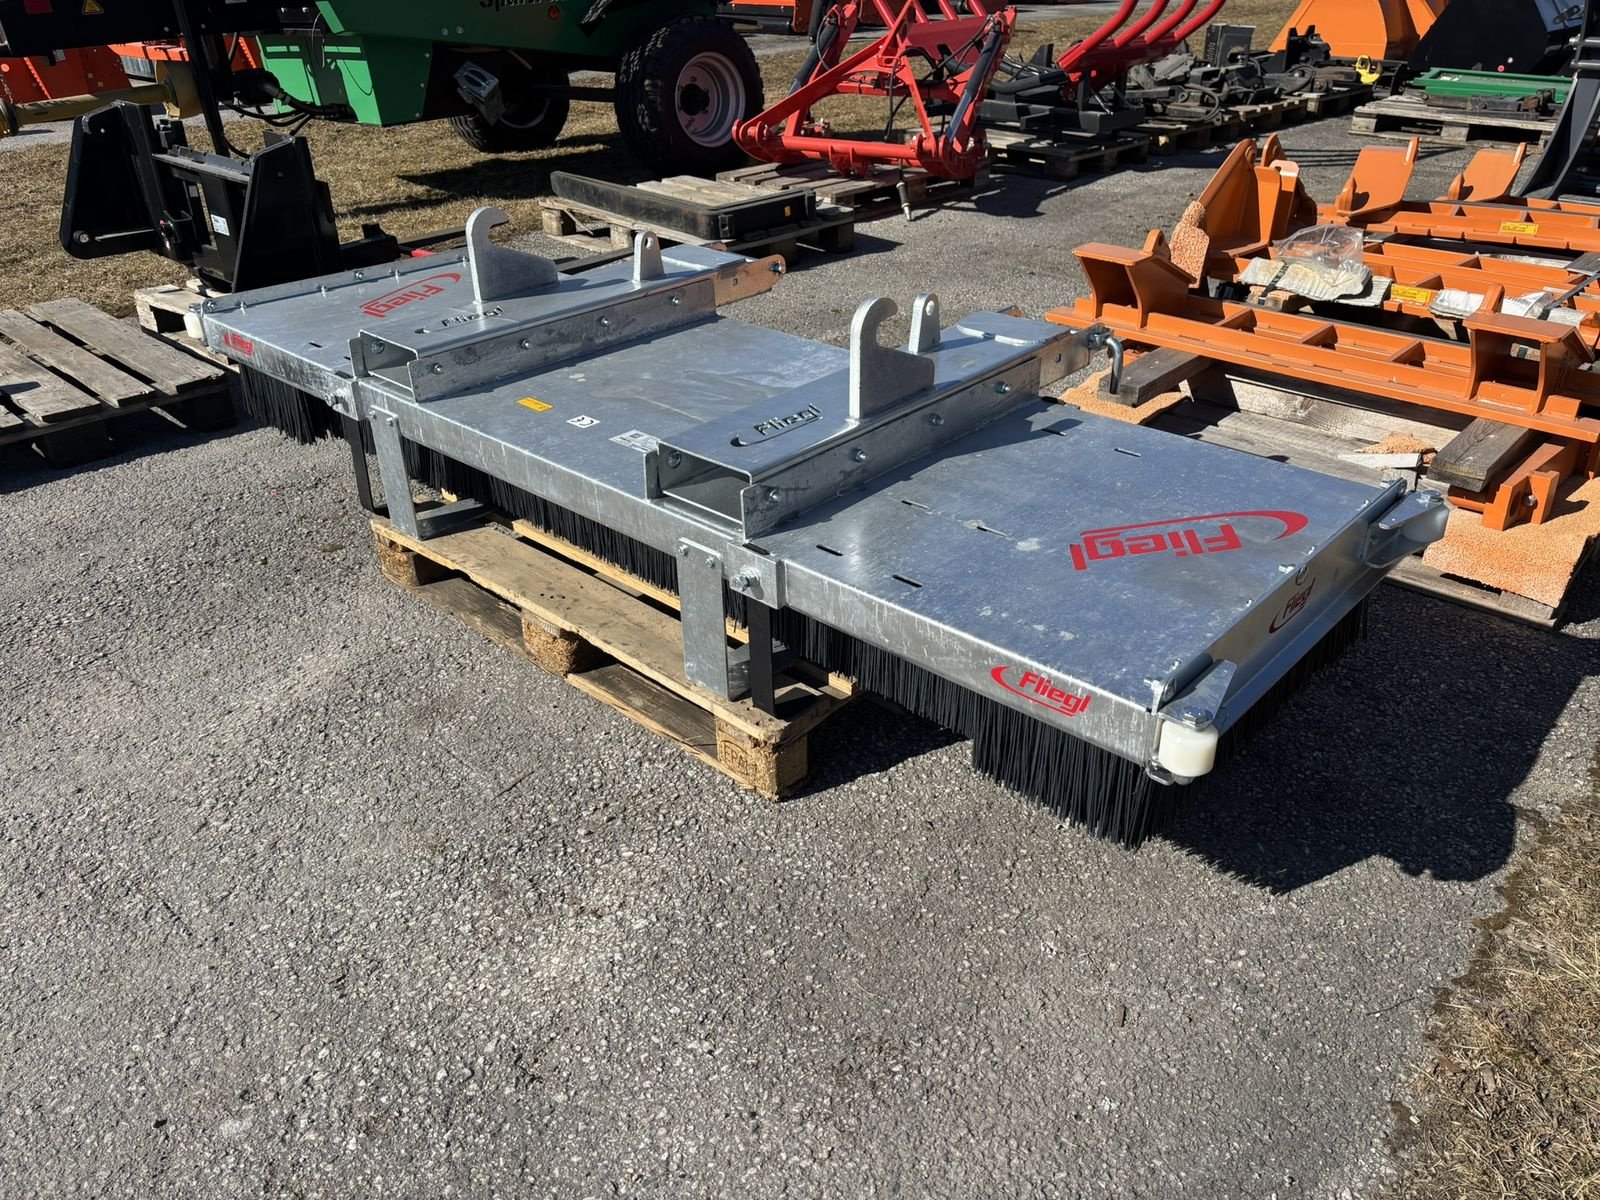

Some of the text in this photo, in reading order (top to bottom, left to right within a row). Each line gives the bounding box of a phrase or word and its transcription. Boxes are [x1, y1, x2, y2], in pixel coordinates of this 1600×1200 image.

[362, 285, 445, 318] Fliegl
[753, 403, 823, 435] Fliegl
[1069, 523, 1242, 571] Fliegl
[1019, 671, 1092, 714] Fliegl
